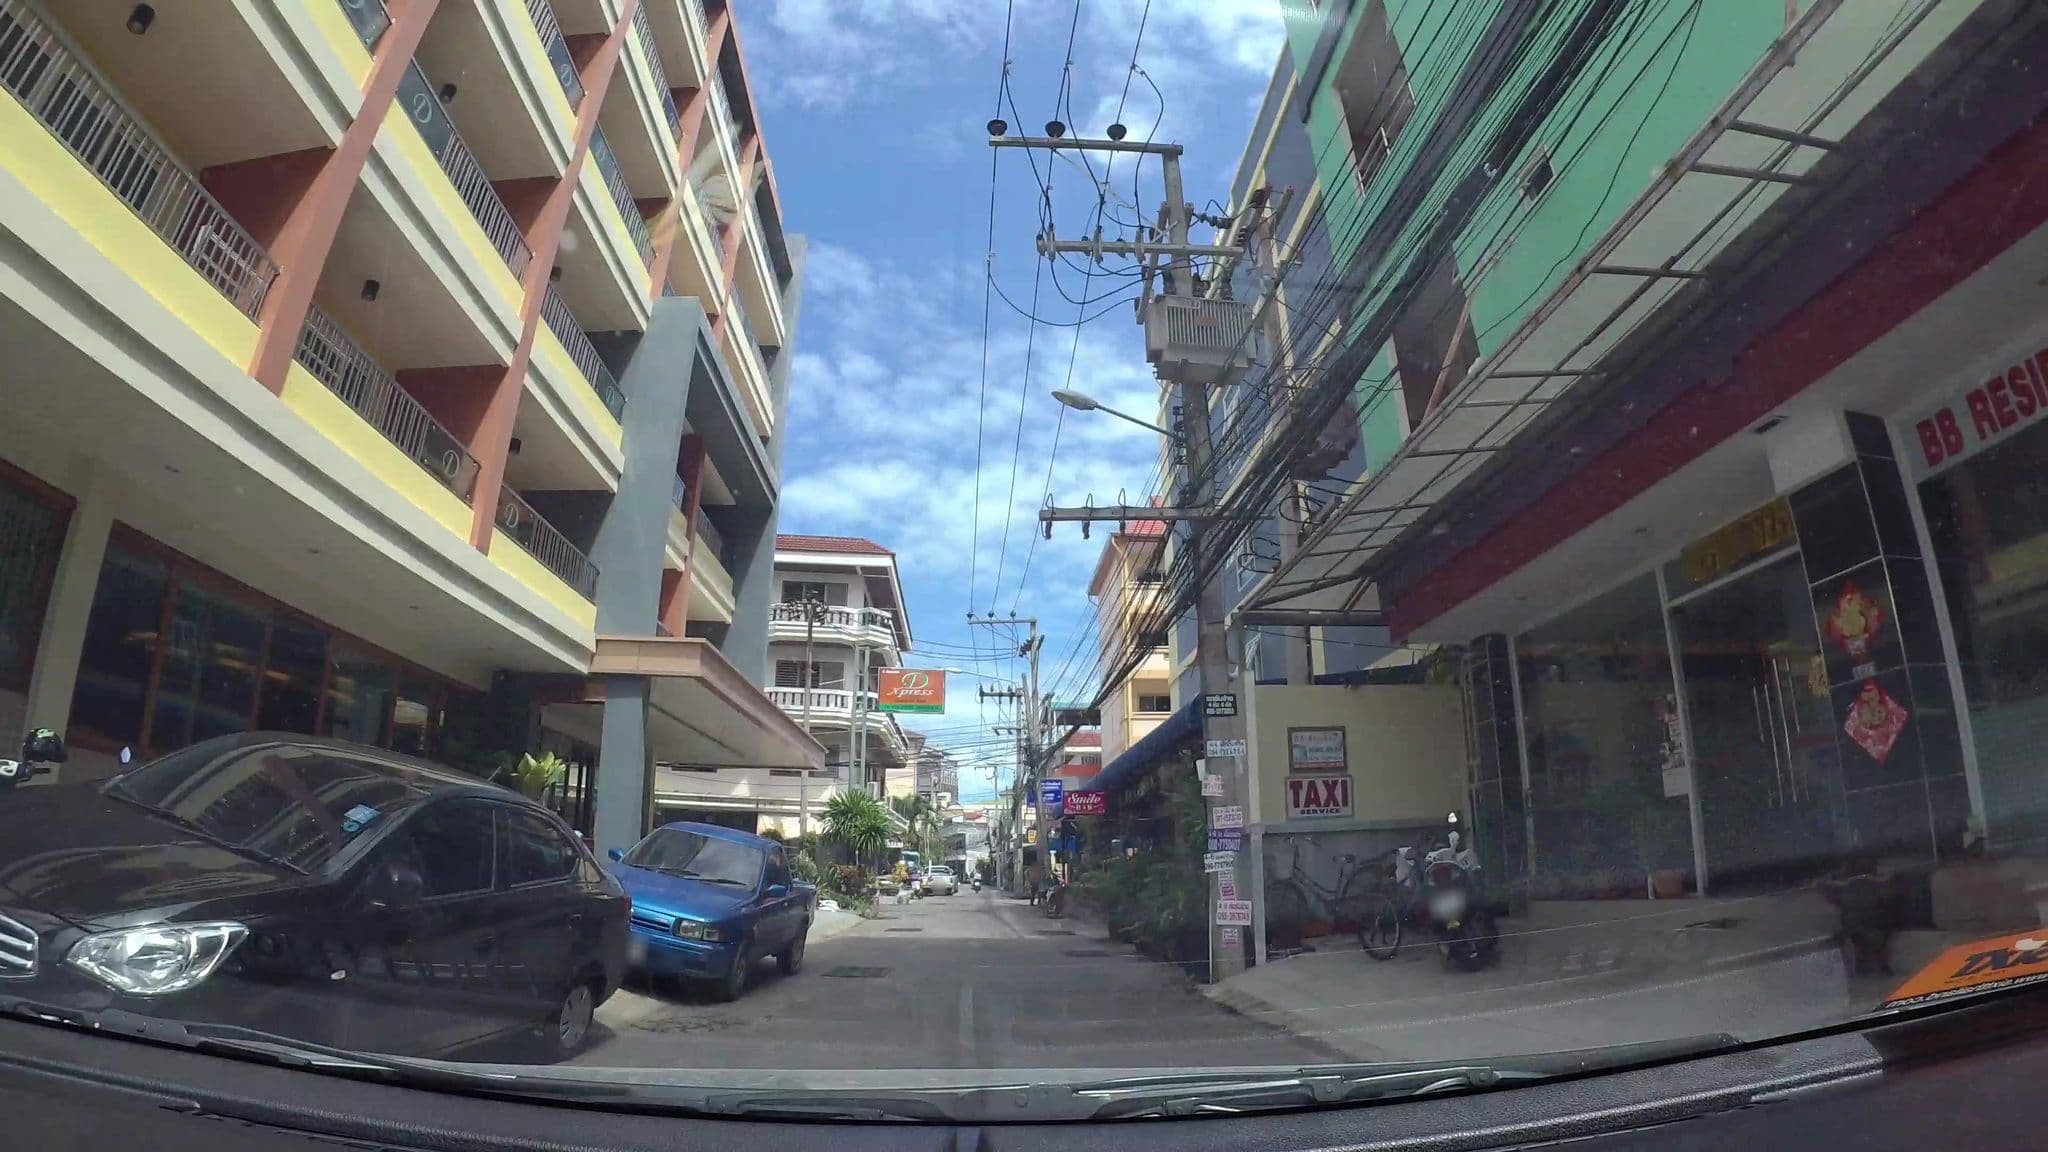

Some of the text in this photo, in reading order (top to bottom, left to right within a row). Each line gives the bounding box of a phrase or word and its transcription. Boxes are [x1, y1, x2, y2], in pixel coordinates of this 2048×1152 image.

[1916, 407, 1964, 468] BB
[1067, 793, 1102, 804] Smile
[1289, 780, 1348, 808] TAXI
